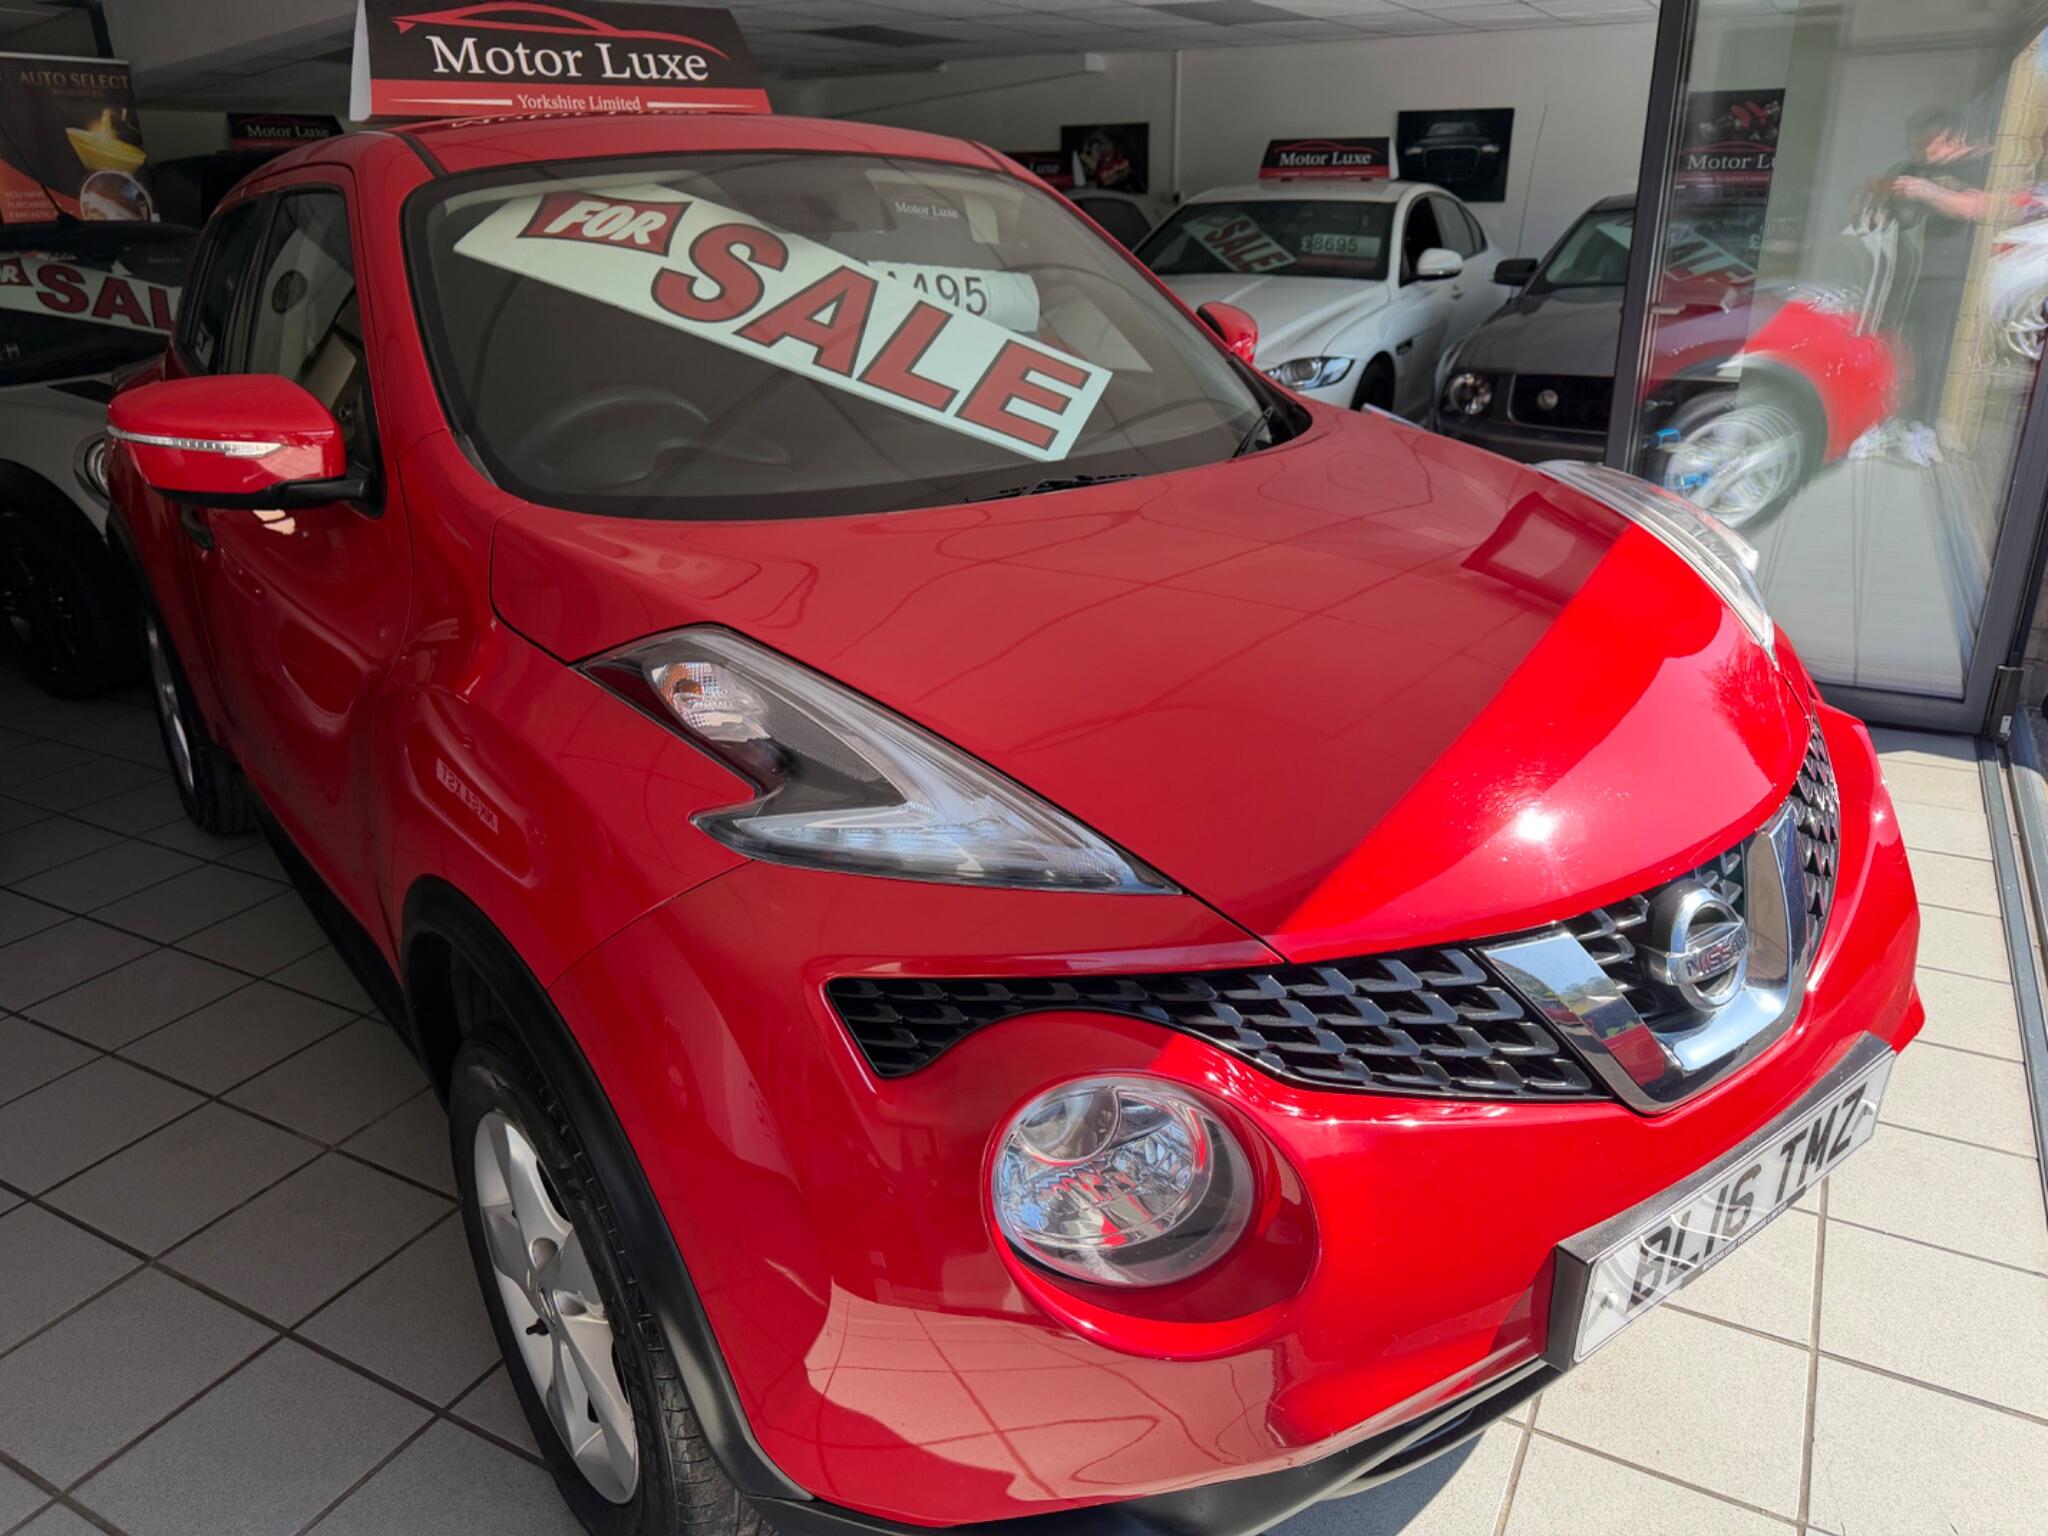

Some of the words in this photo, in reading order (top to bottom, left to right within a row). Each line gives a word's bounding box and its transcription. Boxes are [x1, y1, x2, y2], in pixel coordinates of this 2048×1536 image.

[425, 35, 583, 77] Motor
[595, 42, 710, 81] Luxe
[20, 70, 66, 87] AUTO
[70, 72, 129, 89] SELECT
[517, 94, 587, 110] Yorkshire
[588, 96, 642, 112] Limited
[246, 124, 293, 138] Motor
[295, 125, 330, 138] Luxe
[1279, 152, 1329, 166] Motor
[1332, 151, 1373, 165] Luxe
[1687, 153, 1752, 171] Motor
[894, 201, 929, 216] Motor
[931, 205, 959, 219] Luxe
[1203, 219, 1288, 272] SALE
[544, 201, 668, 246] FOR
[651, 223, 1092, 451] SALE
[1685, 932, 1748, 977] NISSAN
[1626, 1163, 1762, 1312] BL16
[1775, 1083, 1867, 1205] TMZ
